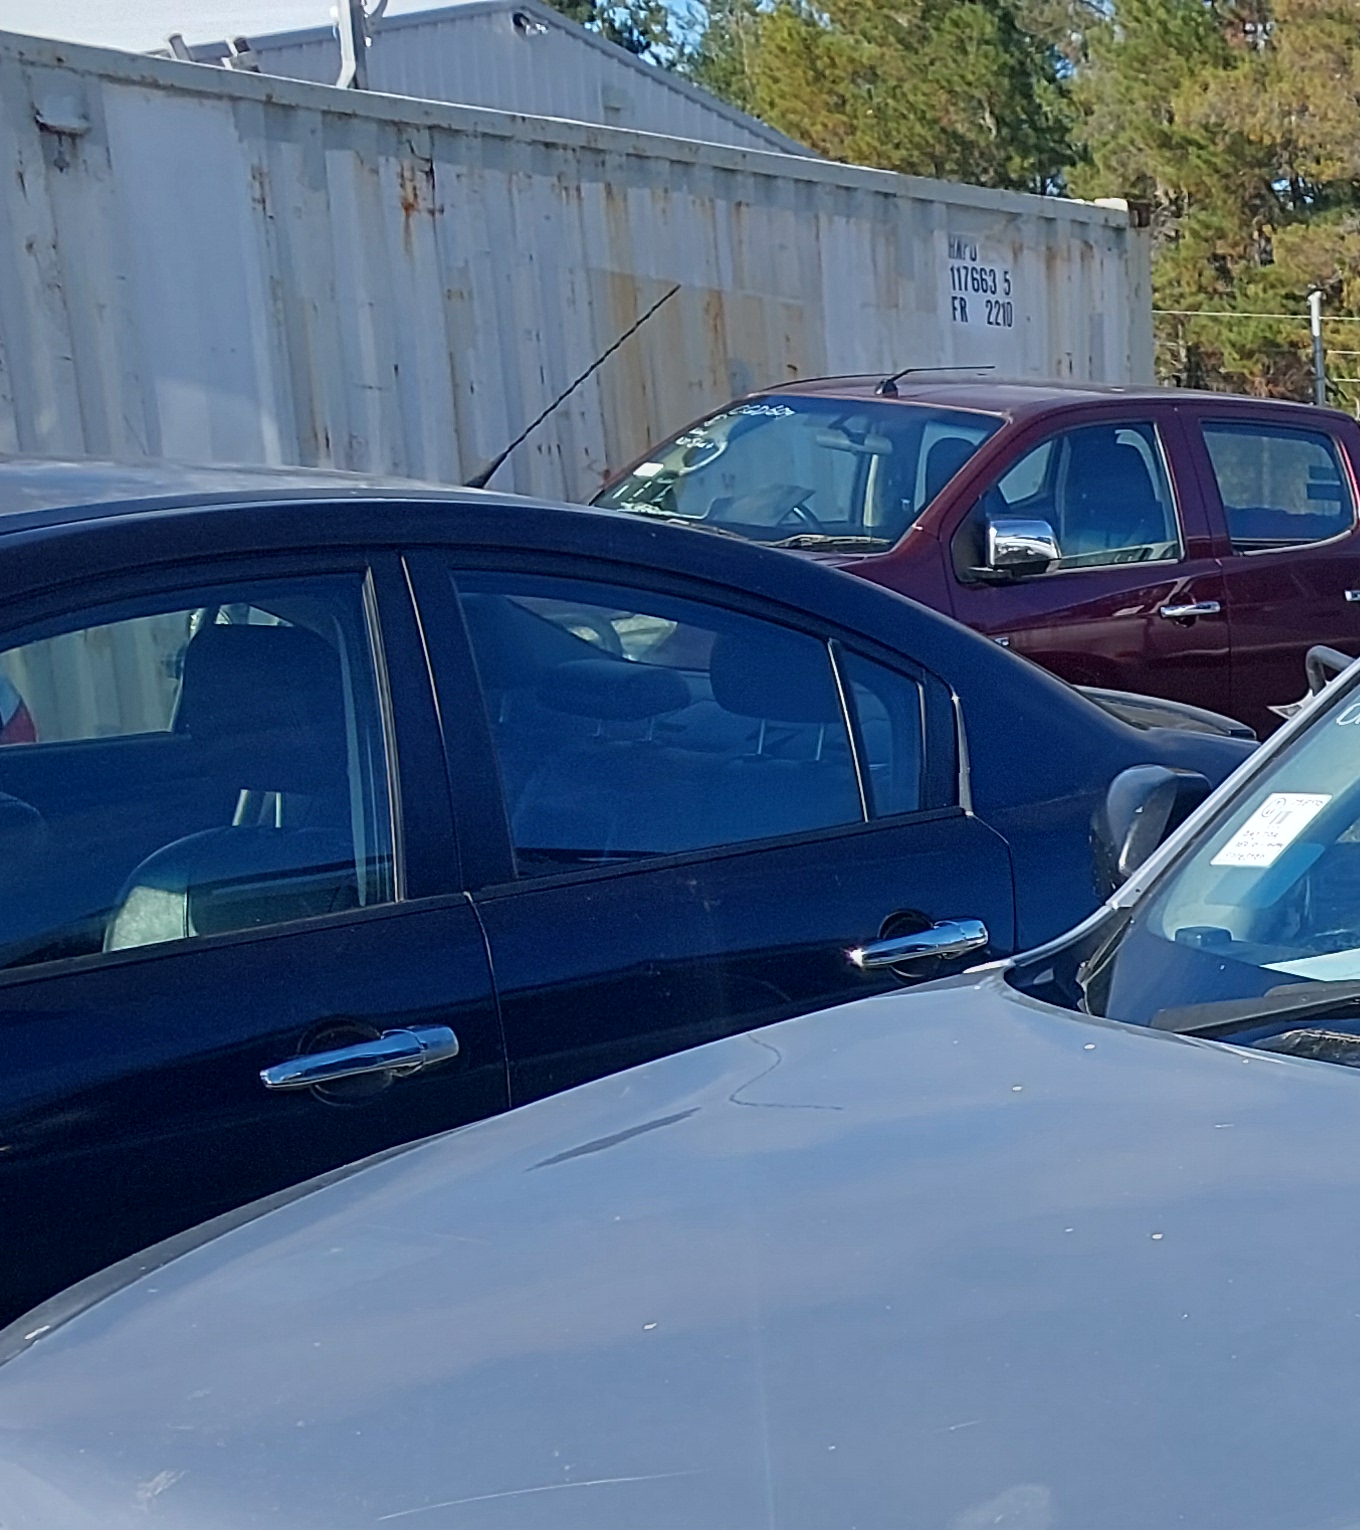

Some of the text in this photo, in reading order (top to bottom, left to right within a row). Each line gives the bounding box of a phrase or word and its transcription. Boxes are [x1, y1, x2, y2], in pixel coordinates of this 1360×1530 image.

[949, 265, 1012, 296] 117663 5
[951, 295, 1014, 328] FR 2210
